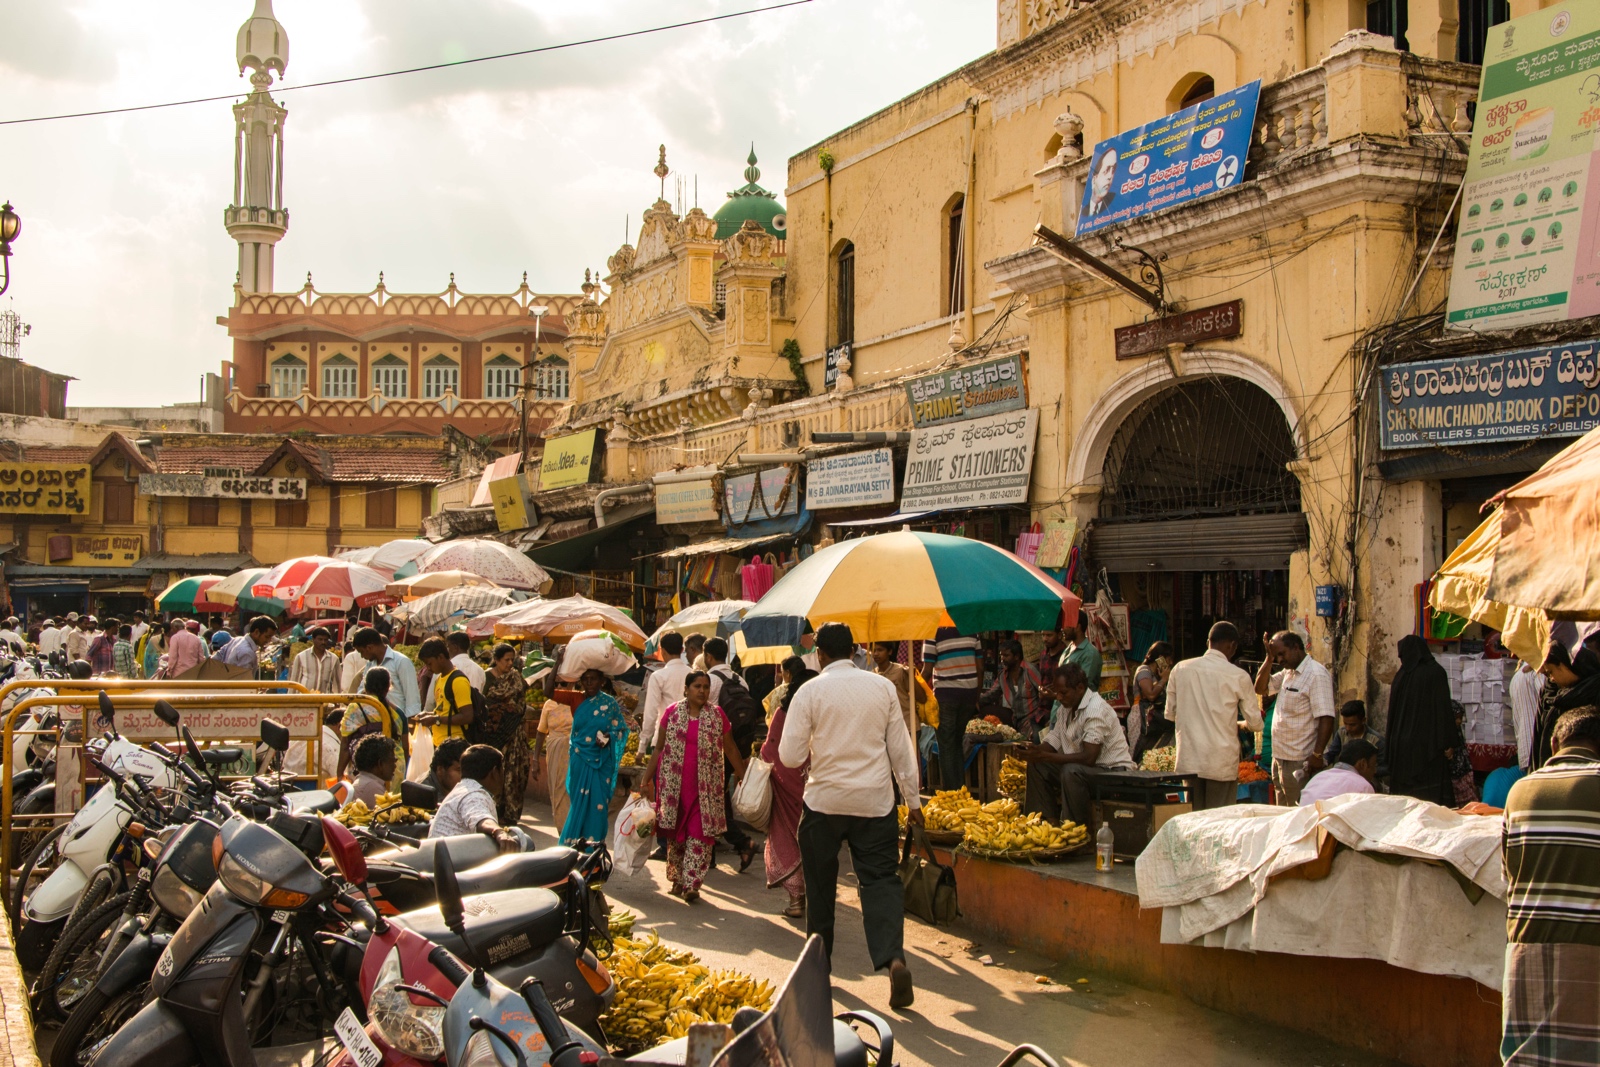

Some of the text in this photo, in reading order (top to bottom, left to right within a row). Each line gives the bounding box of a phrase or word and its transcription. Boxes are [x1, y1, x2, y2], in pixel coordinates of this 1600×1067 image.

[1516, 48, 1558, 76] ಮೈಸೂರು
[1514, 134, 1548, 149] Swachhata
[1191, 149, 1222, 171] ಸಮಿತಿ
[1498, 287, 1517, 300] 2017
[1390, 371, 1411, 405] ಶ್ರೀ
[1414, 357, 1505, 397] ರಾಮಚಂದ್ರ
[1507, 351, 1552, 388] ಬುಕ್
[914, 394, 964, 423] PRIME
[963, 384, 1019, 409] Stationers
[1388, 408, 1407, 431] SRI
[1410, 400, 1502, 429] RAMACHANDRA
[1506, 398, 1544, 423] BOOK
[916, 416, 1027, 454] ಪ್ರೈಮ್ ಸ್ಟೇಷನರ್ಸ್
[1393, 433, 1418, 443] BOOK
[907, 445, 1027, 485] PRIME STATIONERS
[826, 482, 870, 496] ADINARAYANA
[871, 479, 890, 491] SETTY
[977, 479, 1000, 488] Computer
[1000, 477, 1025, 486] Stationery
[678, 490, 694, 503] COFFEE
[918, 498, 936, 507] Devaraja
[937, 497, 952, 505] Market,
[564, 623, 584, 631] more
[618, 630, 633, 640] more
[184, 713, 211, 729] ನಗರ
[214, 713, 258, 729] ಸಂಚಾರ
[235, 853, 261, 874] HONDA
[487, 933, 528, 956] MAHALAKSHMI
